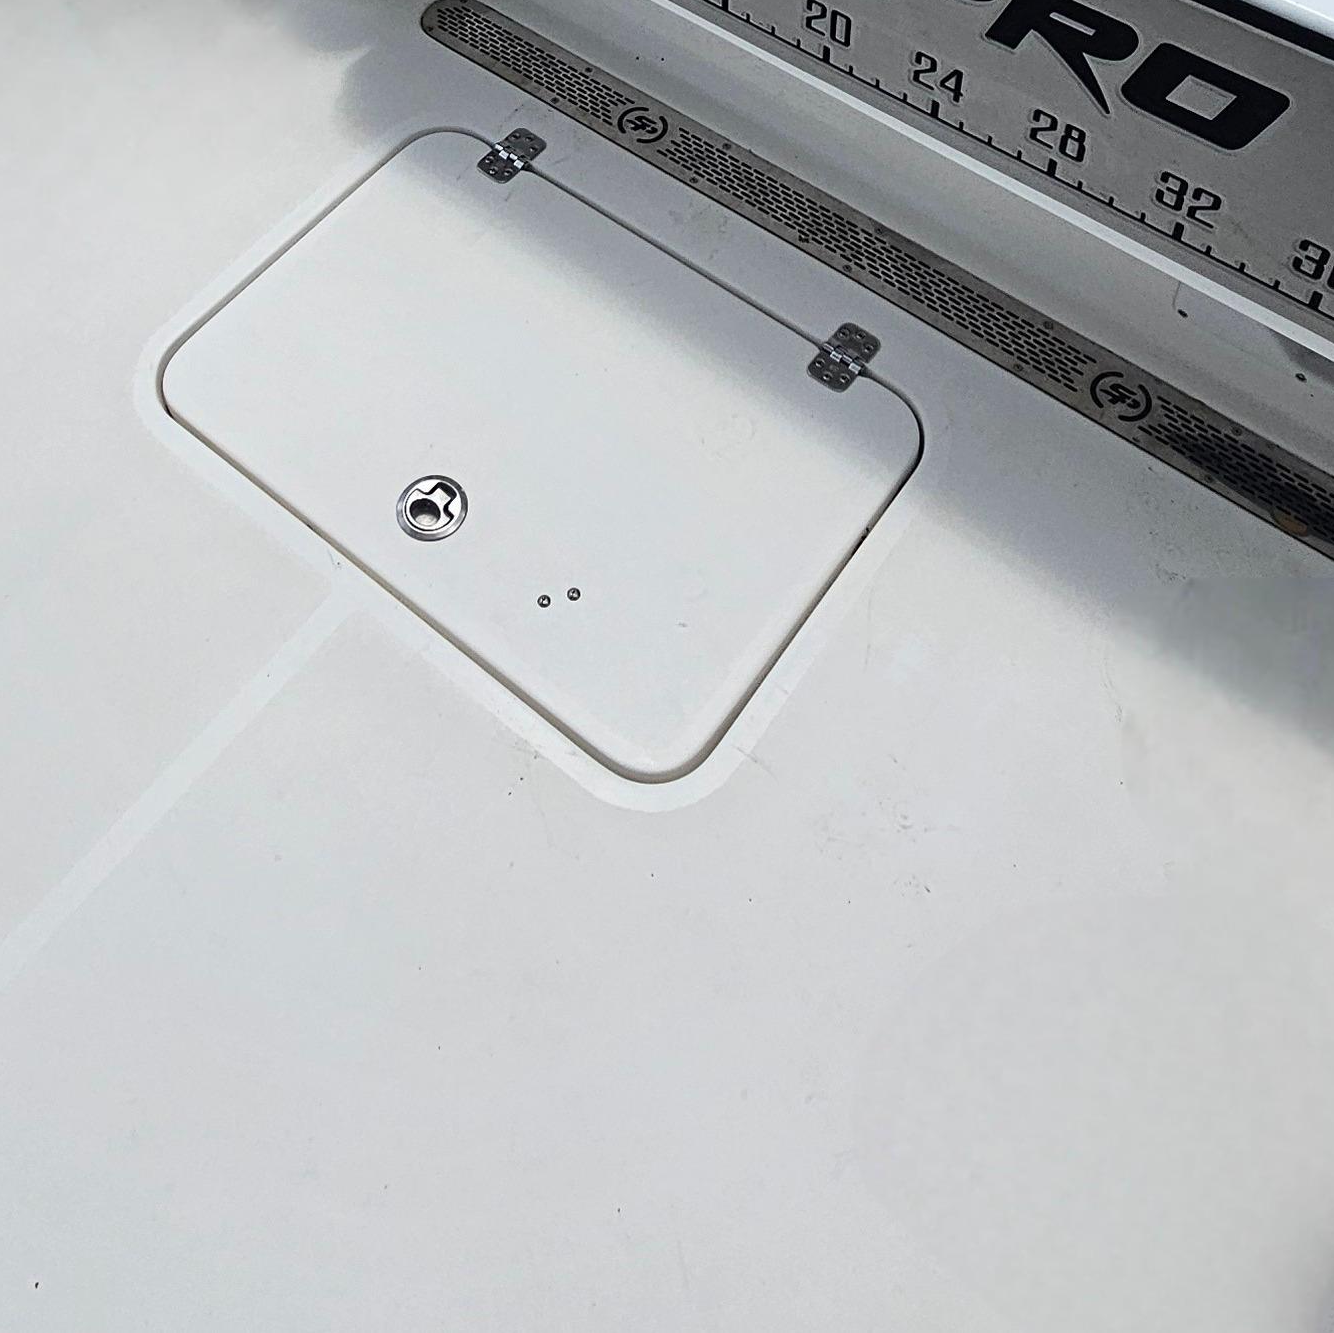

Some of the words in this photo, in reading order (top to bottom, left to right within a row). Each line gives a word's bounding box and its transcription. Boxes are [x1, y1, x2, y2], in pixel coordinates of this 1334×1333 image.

[912, 51, 964, 104] 24
[1028, 108, 1087, 163] 28
[1154, 170, 1223, 229] 32
